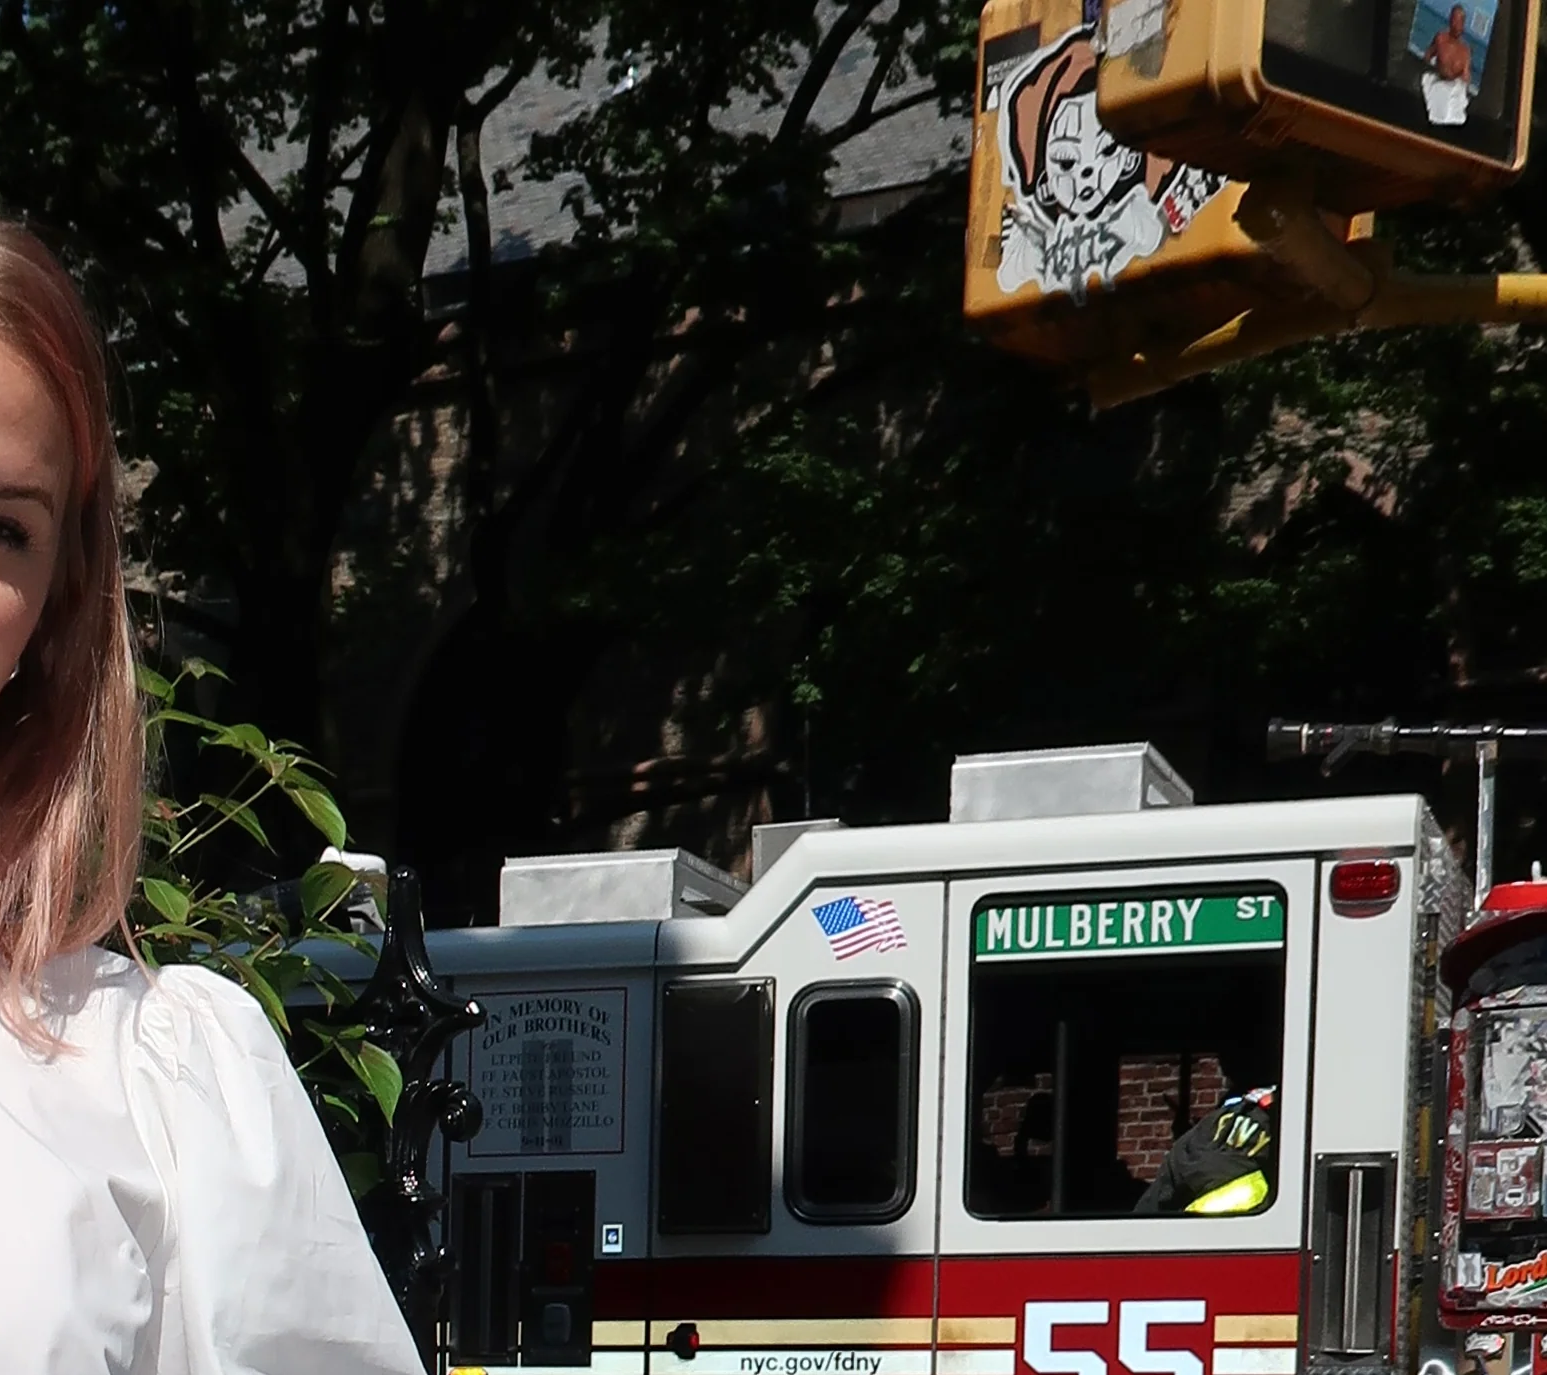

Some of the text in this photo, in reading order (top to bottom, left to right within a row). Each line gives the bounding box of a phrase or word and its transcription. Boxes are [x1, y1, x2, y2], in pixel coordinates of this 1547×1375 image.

[987, 896, 1275, 951] MULBERRY ST
[484, 998, 611, 1033] IN MEMORY OF
[482, 1016, 611, 1050] OUR BROTHERS
[740, 1351, 882, 1375] nyc.gov/fdny
